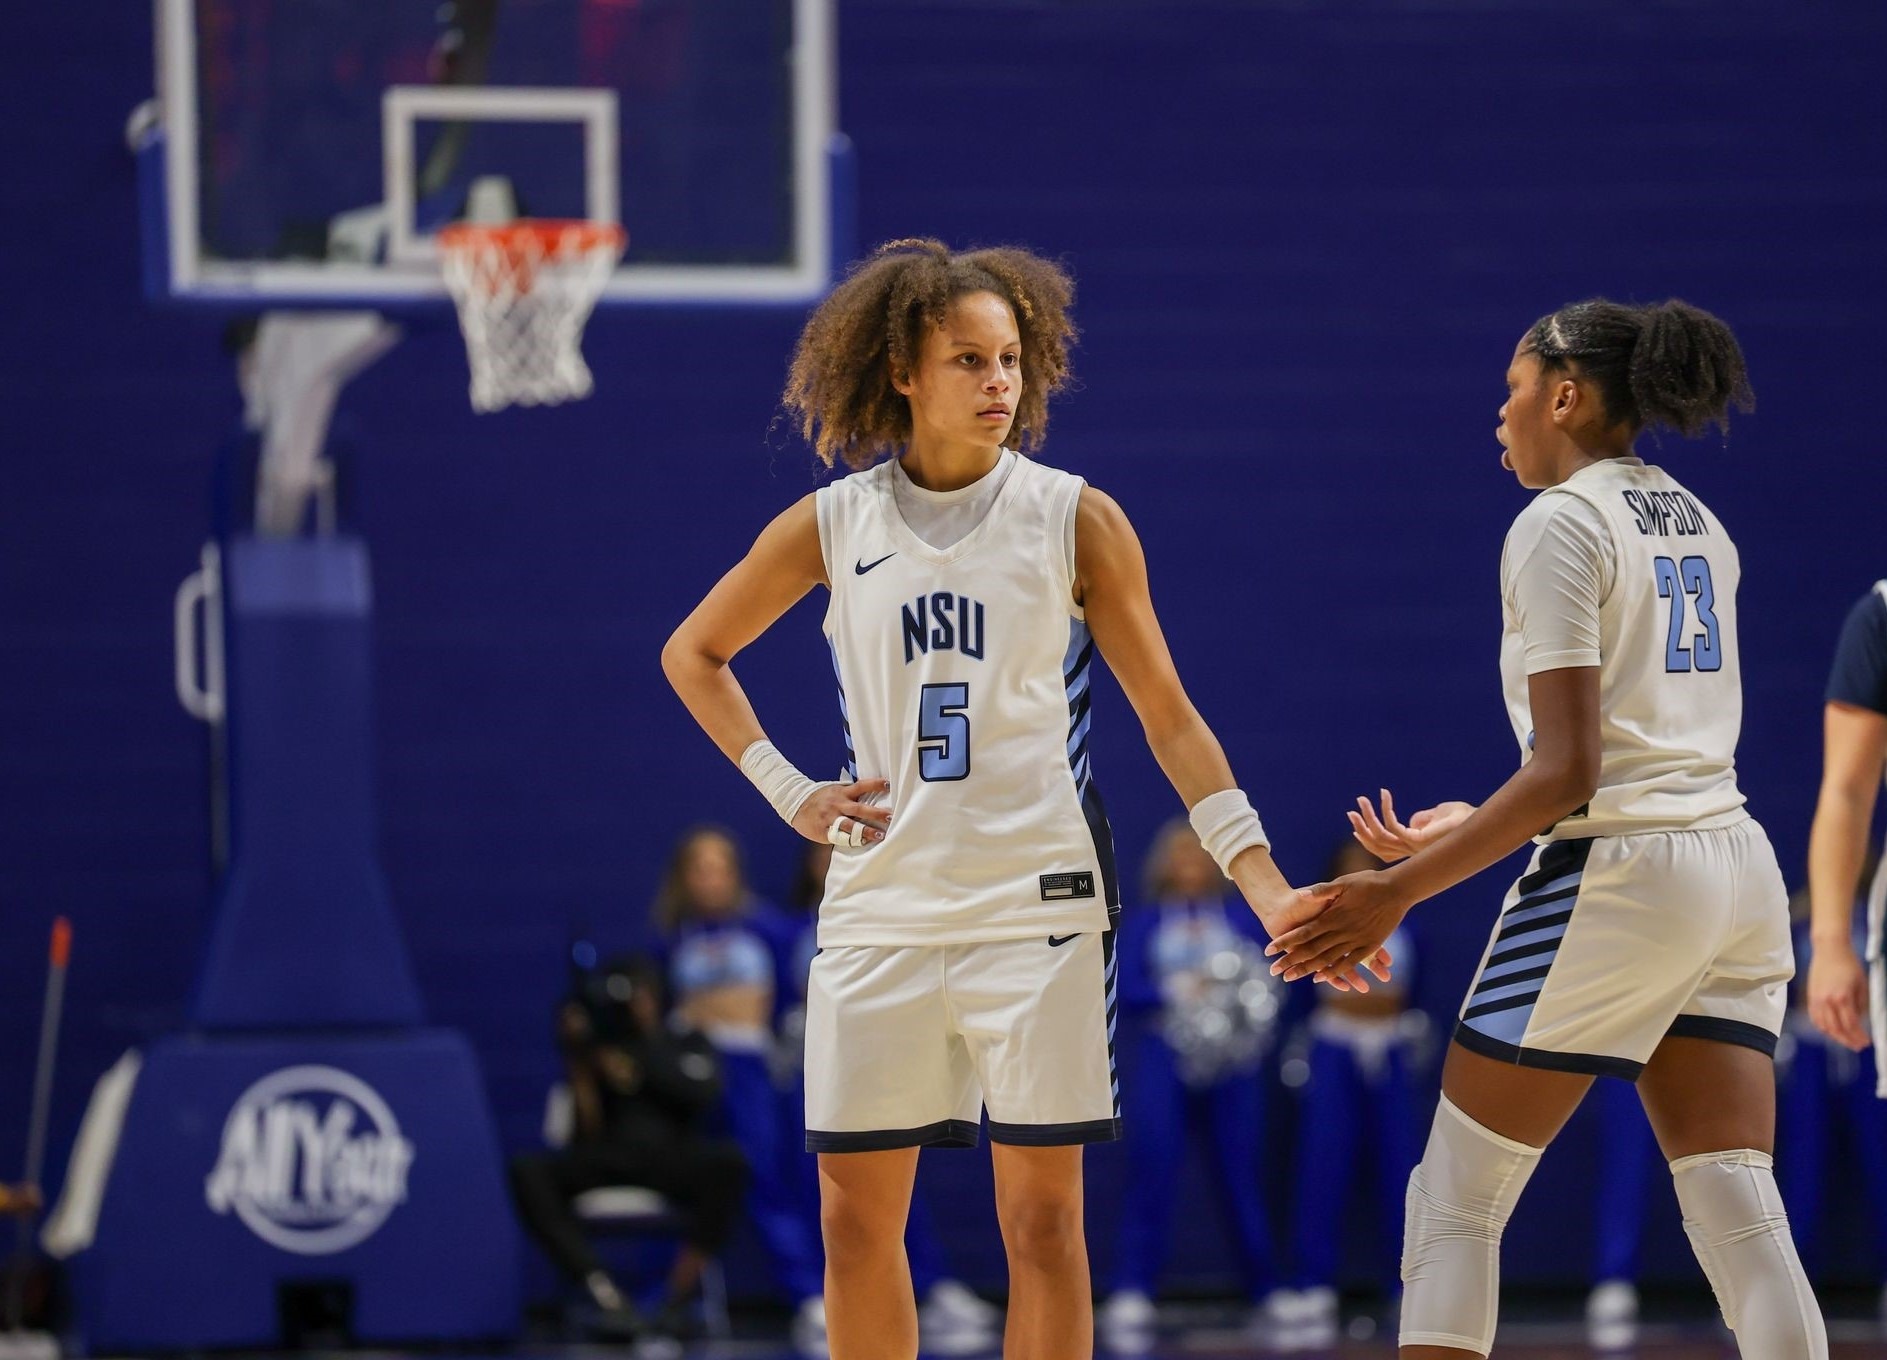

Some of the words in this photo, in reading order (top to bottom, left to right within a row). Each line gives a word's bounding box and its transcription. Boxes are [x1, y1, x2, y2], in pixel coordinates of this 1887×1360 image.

[1622, 489, 1709, 537] SIMPSON
[901, 591, 985, 666] NSU
[1654, 555, 1722, 673] 23
[918, 682, 971, 782] 5
[1079, 879, 1088, 890] M
